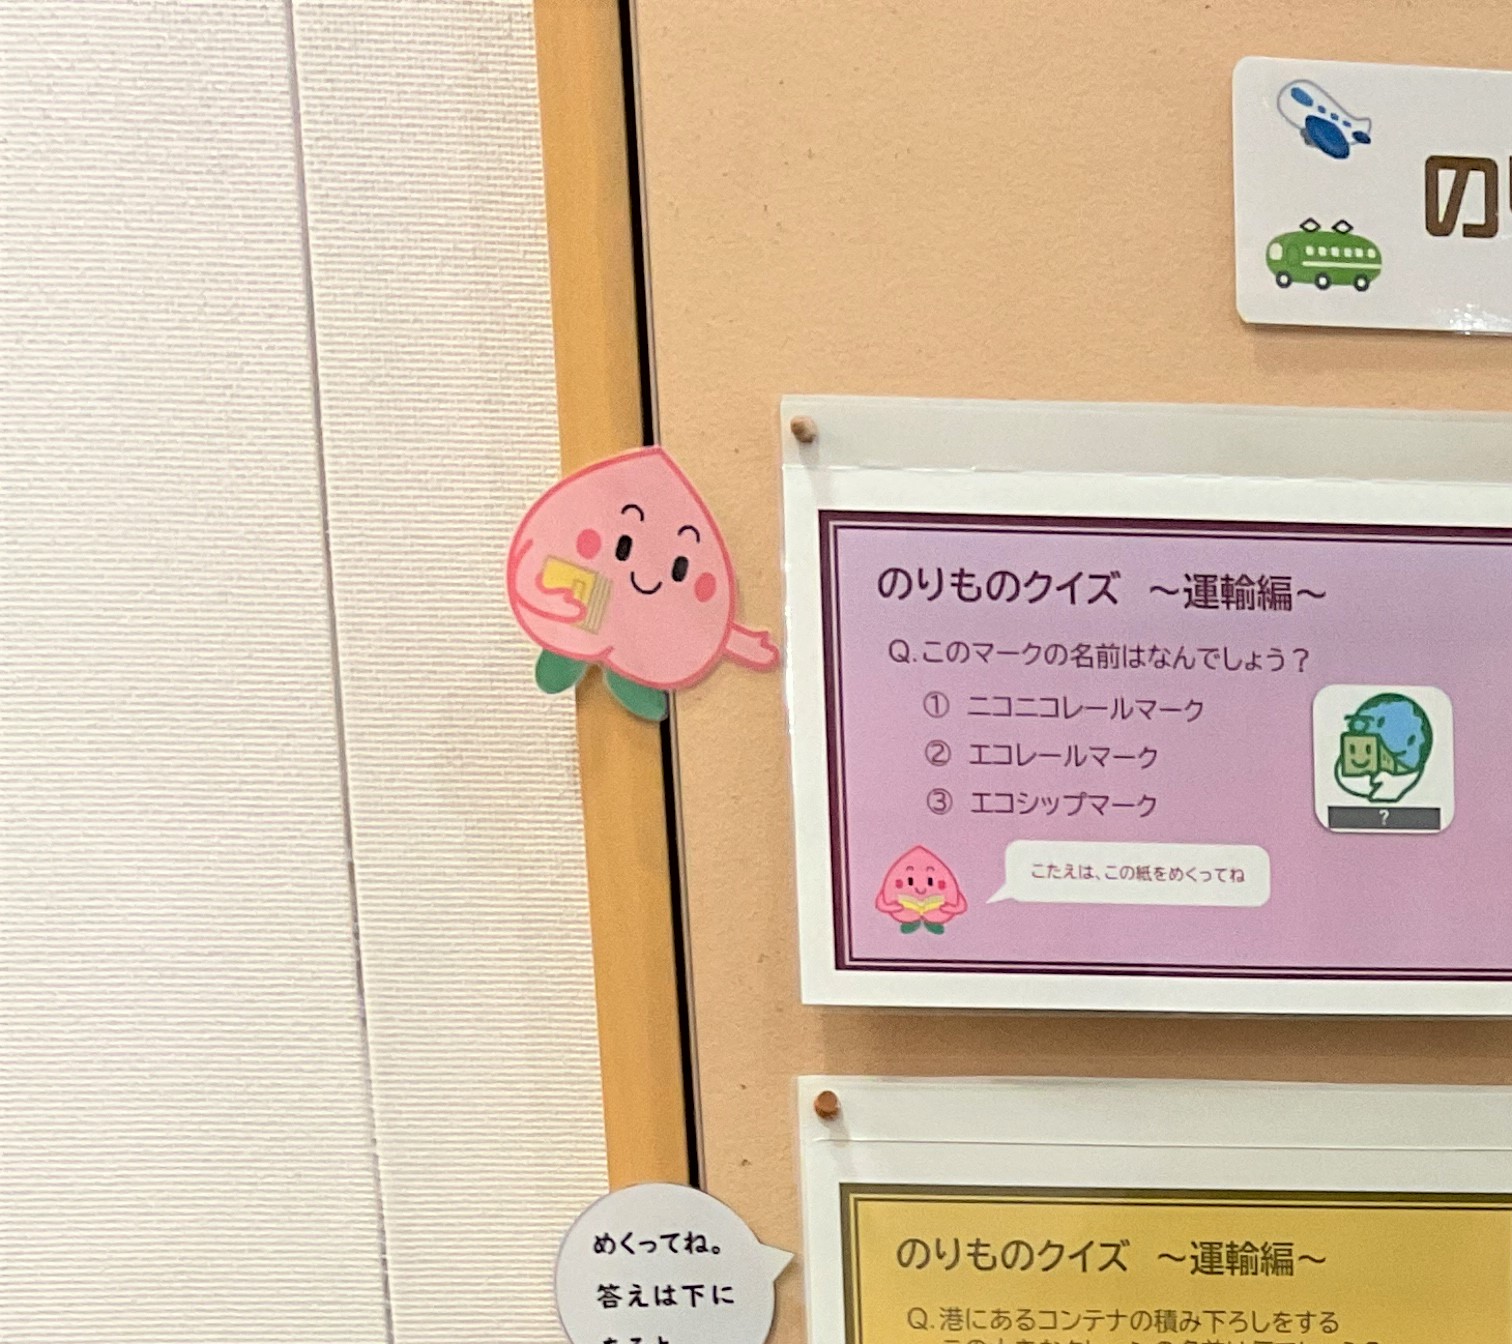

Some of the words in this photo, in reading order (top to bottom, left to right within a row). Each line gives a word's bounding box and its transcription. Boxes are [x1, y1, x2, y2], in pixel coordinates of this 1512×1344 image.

[876, 566, 1121, 606] のりものクイズ
[967, 694, 1205, 722] ニコニコレールマーク
[969, 743, 1160, 770] エコレールマーク
[970, 791, 1158, 819] エコシップマーク
[1031, 861, 1246, 884] こたえは、この紙をめくってね
[592, 1230, 722, 1256] めくってね。
[897, 1236, 1130, 1274] のりものクイズ
[596, 1283, 736, 1310] 答えは下に
